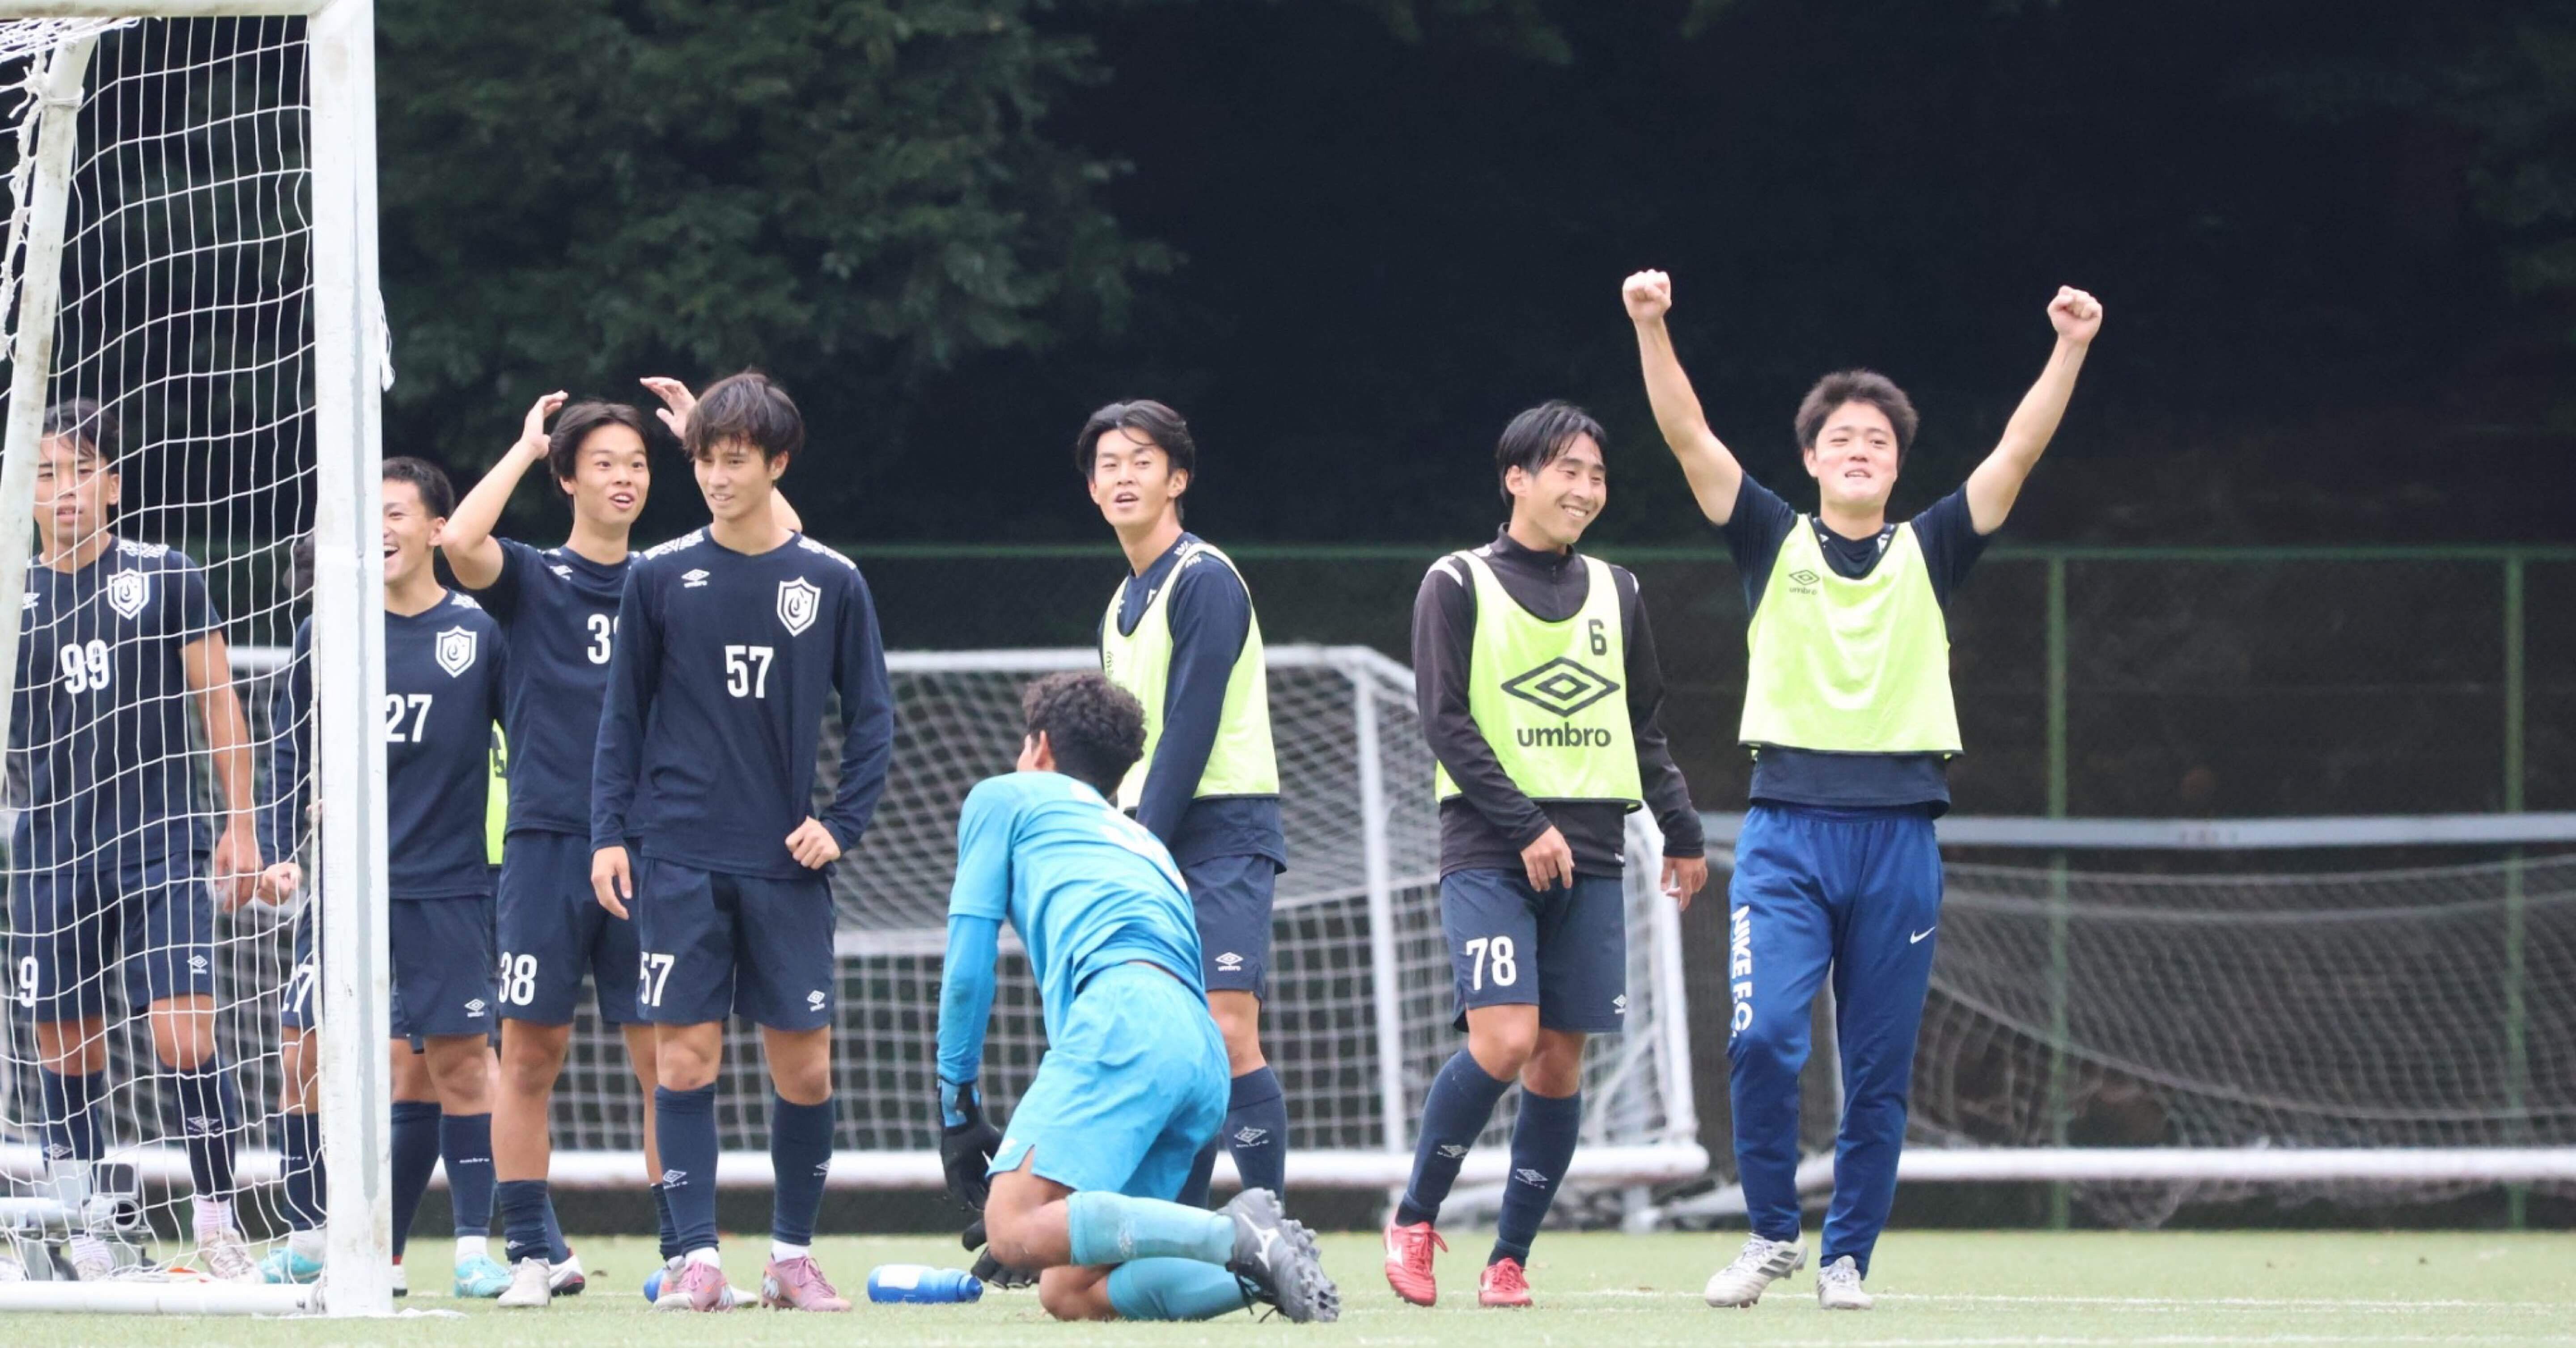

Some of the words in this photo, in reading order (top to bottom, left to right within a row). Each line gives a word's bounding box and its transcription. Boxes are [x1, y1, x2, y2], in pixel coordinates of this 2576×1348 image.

[587, 613, 619, 664] 3
[1588, 619, 1606, 656] 6
[60, 639, 110, 693] 99
[725, 645, 774, 698] 57
[386, 693, 433, 742] 27
[1517, 722, 1612, 747] umbro
[1466, 936, 1516, 990] 78
[1731, 905, 1752, 979] NIKE
[499, 952, 537, 1006] 38
[640, 951, 674, 1006] 57
[1733, 982, 1753, 1037] F.C.
